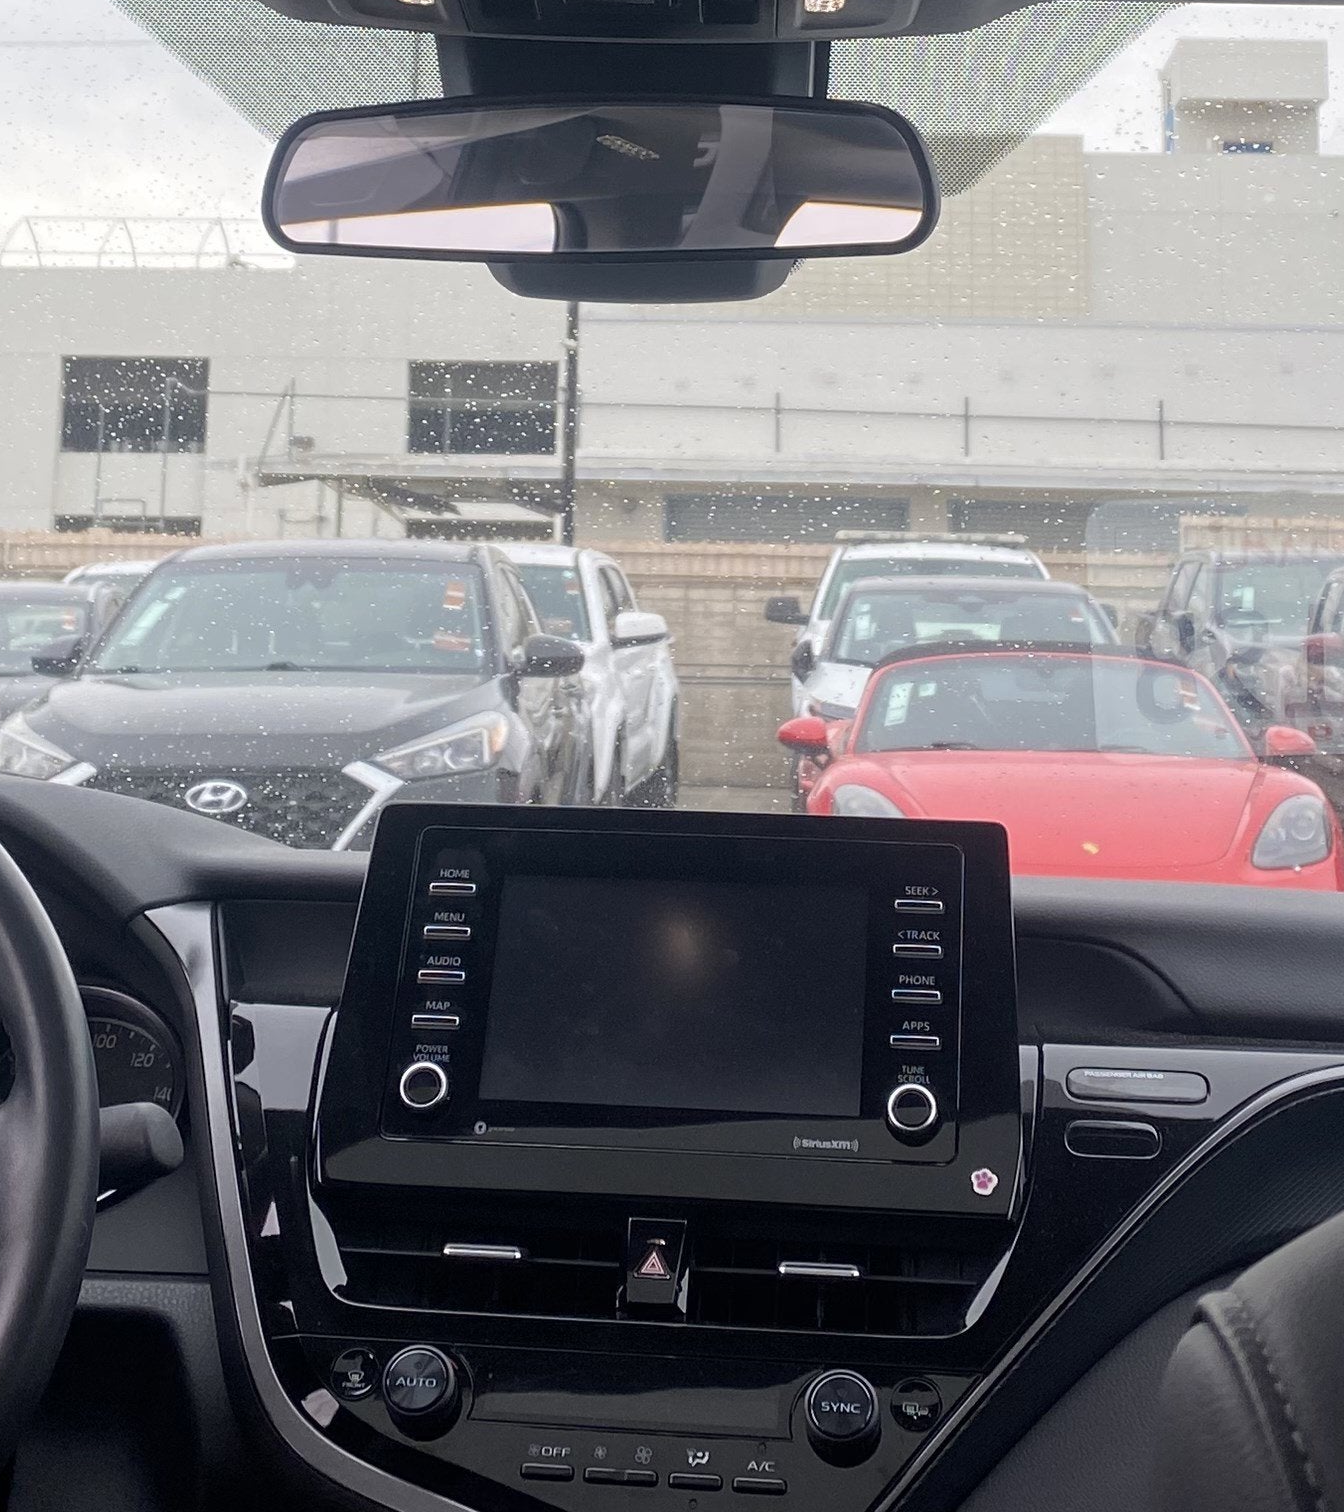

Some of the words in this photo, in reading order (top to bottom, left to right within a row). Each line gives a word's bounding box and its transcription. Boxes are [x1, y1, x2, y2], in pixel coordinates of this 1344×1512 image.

[440, 868, 470, 879] HOME
[905, 886, 929, 896] SEEK
[434, 912, 465, 923] MENU
[906, 930, 940, 941] TRACK
[426, 956, 461, 967] AUDIO
[899, 974, 936, 986] PHONE
[425, 1001, 451, 1011] MAP
[902, 1021, 930, 1032] APPS
[416, 1044, 449, 1054] POWER
[130, 1052, 155, 1068] 120
[413, 1053, 451, 1063] VOLUME
[902, 1065, 925, 1075] TUNE
[898, 1074, 930, 1085] SCROLL
[395, 1376, 437, 1388] AUTO
[820, 1400, 862, 1415] SYNC
[540, 1445, 571, 1458] OFF
[747, 1460, 776, 1473] A/C
